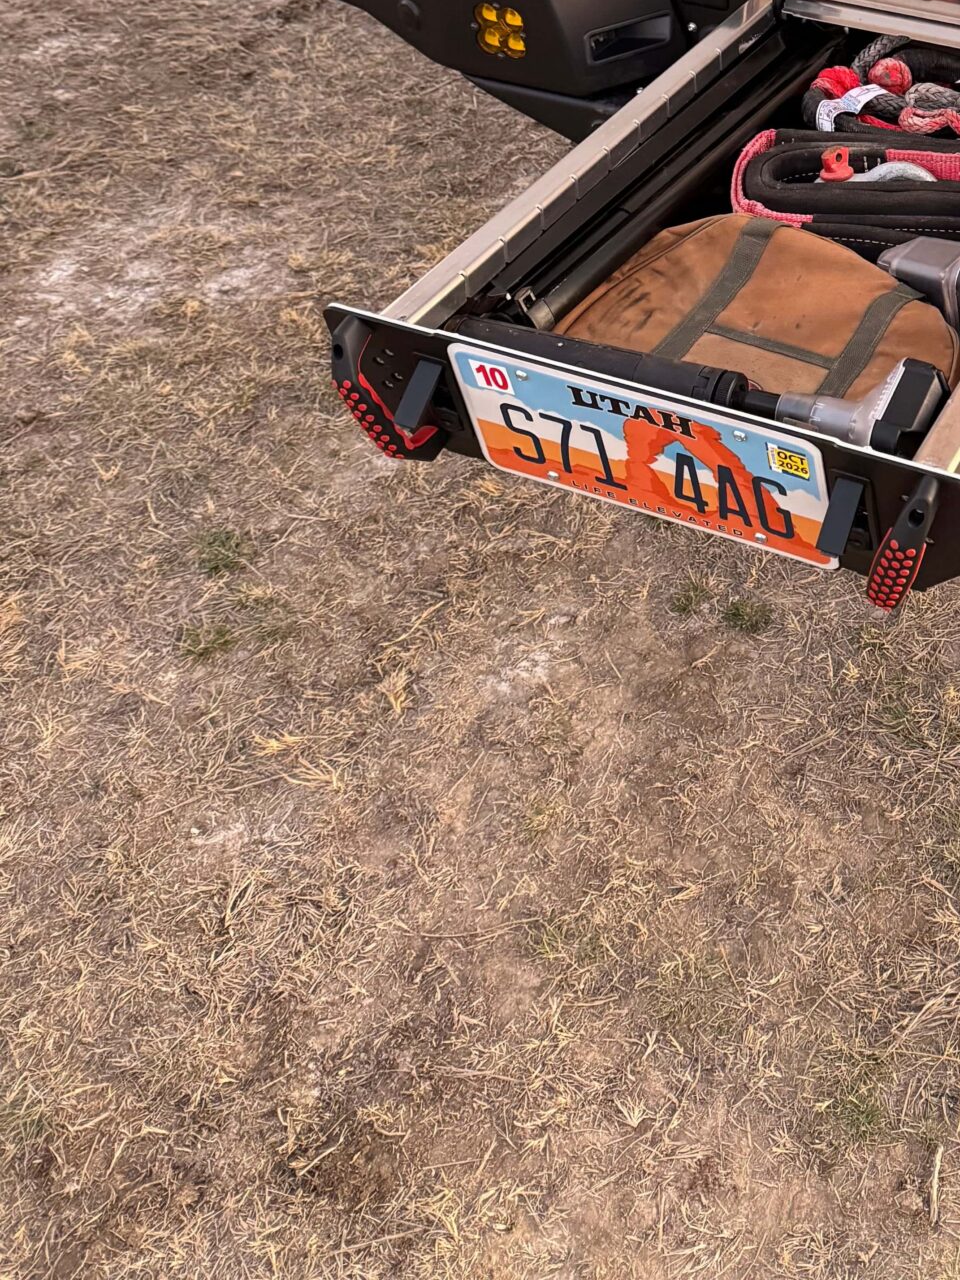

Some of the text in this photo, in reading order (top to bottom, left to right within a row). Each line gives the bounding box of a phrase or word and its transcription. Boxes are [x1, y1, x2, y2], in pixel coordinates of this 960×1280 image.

[475, 364, 509, 391] 10
[567, 385, 696, 439] UTAH
[500, 403, 795, 539] S71 4AG
[777, 451, 807, 467] OCT
[778, 460, 808, 475] 2026
[572, 480, 743, 537] LIFE ELEVATED
